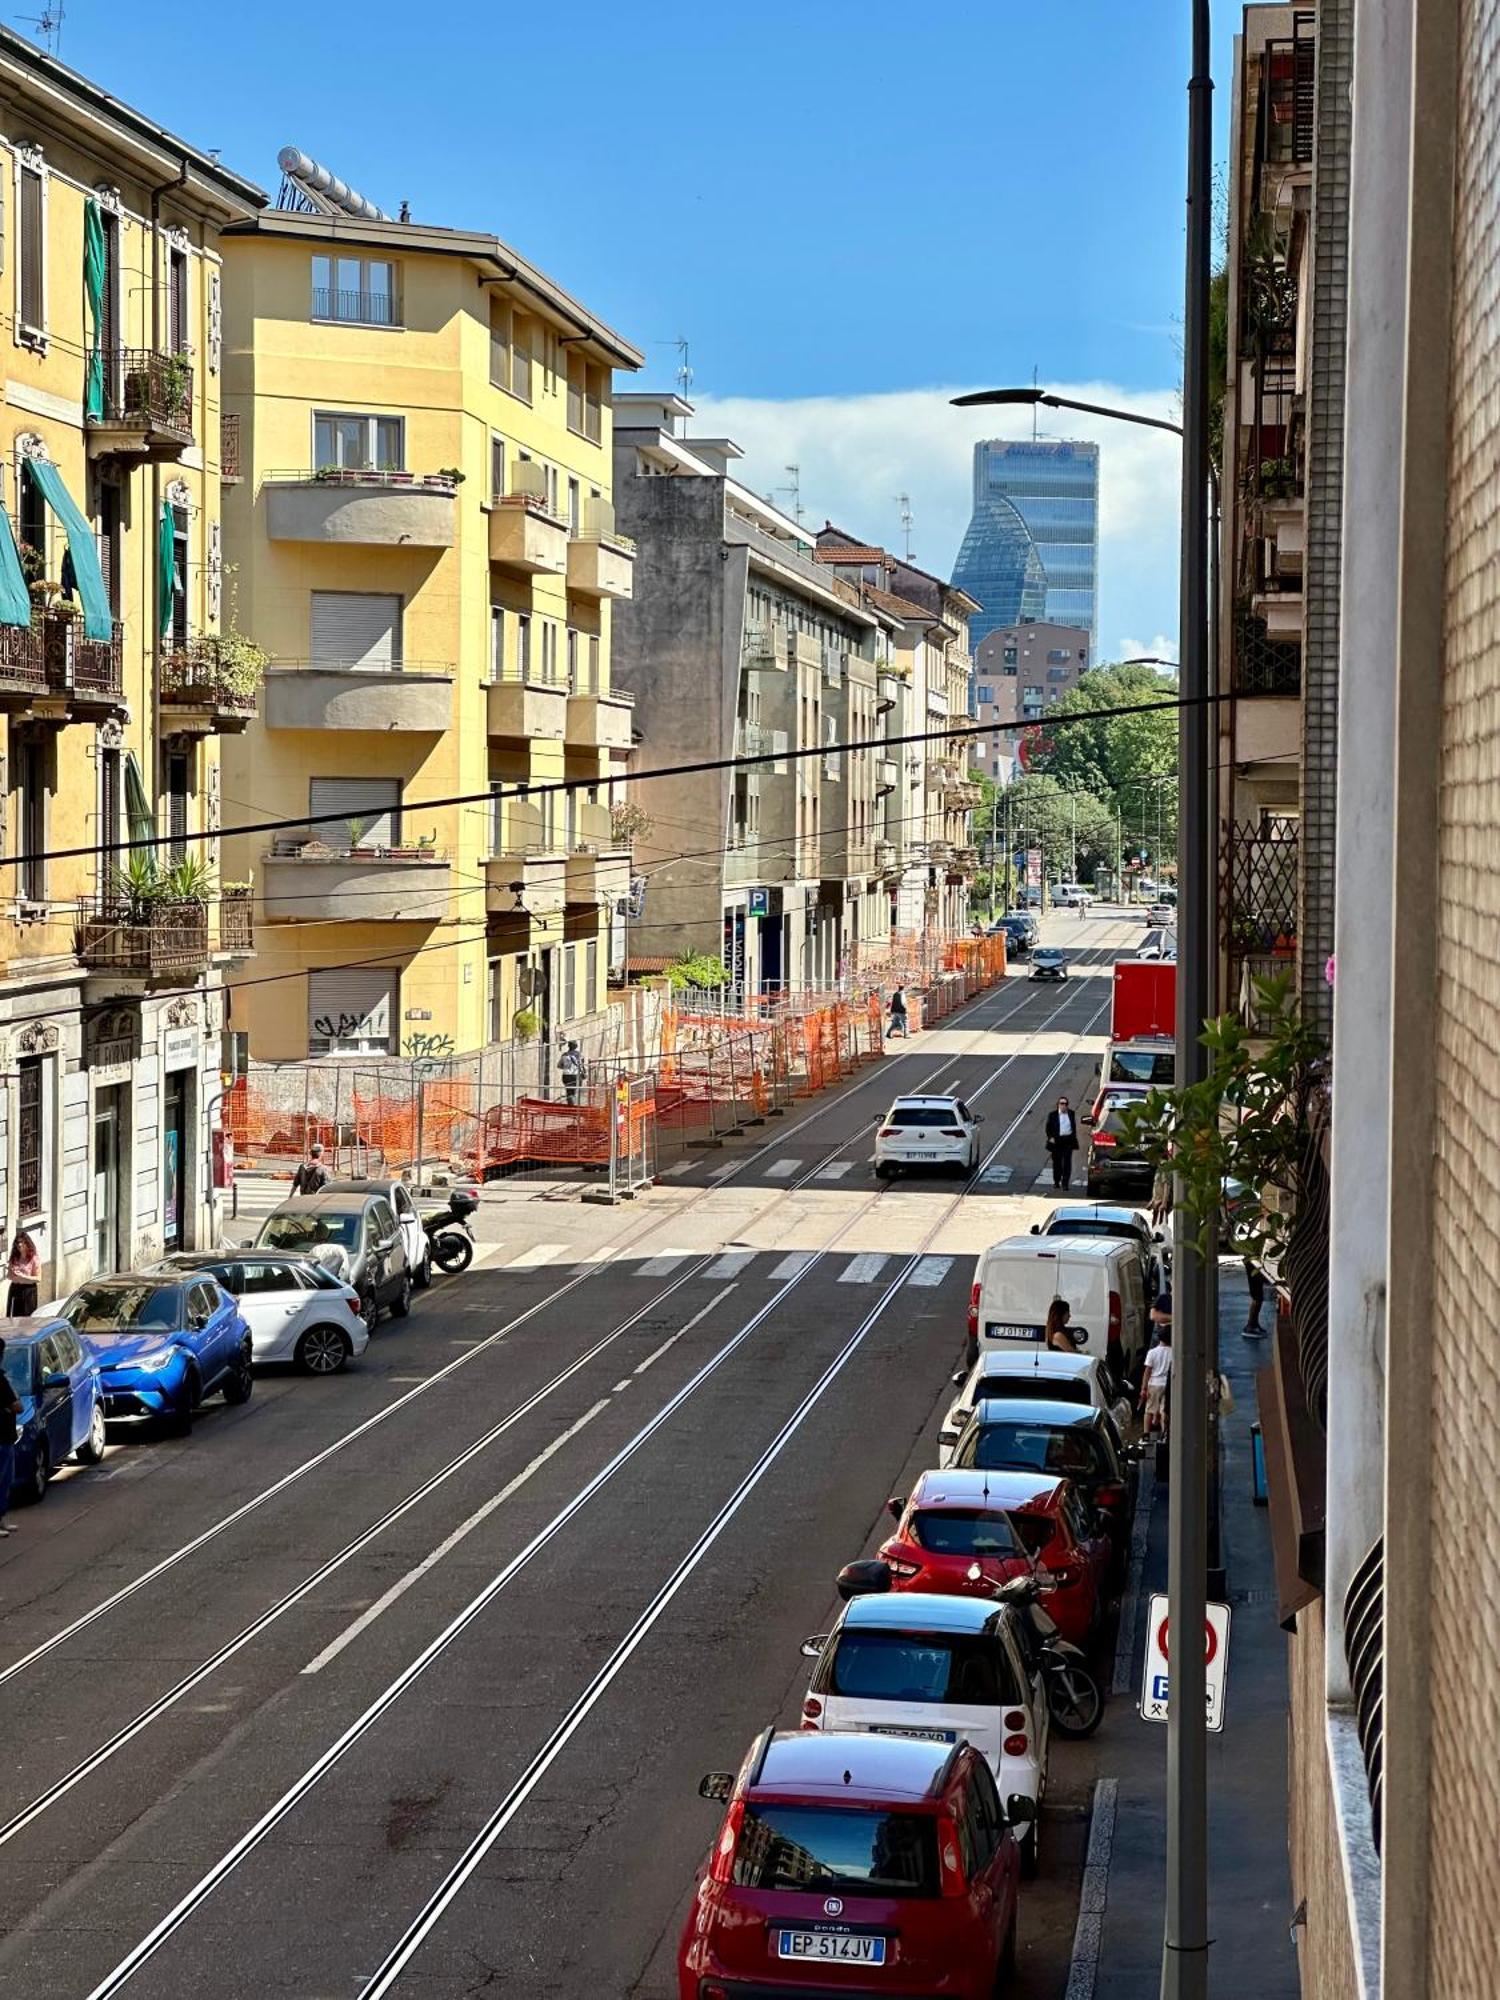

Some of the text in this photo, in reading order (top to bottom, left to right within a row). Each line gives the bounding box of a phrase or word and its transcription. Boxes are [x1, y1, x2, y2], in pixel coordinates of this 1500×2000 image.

[753, 892, 764, 907] P
[792, 1935, 813, 1953] EP
[820, 1937, 872, 1958] 514JV
